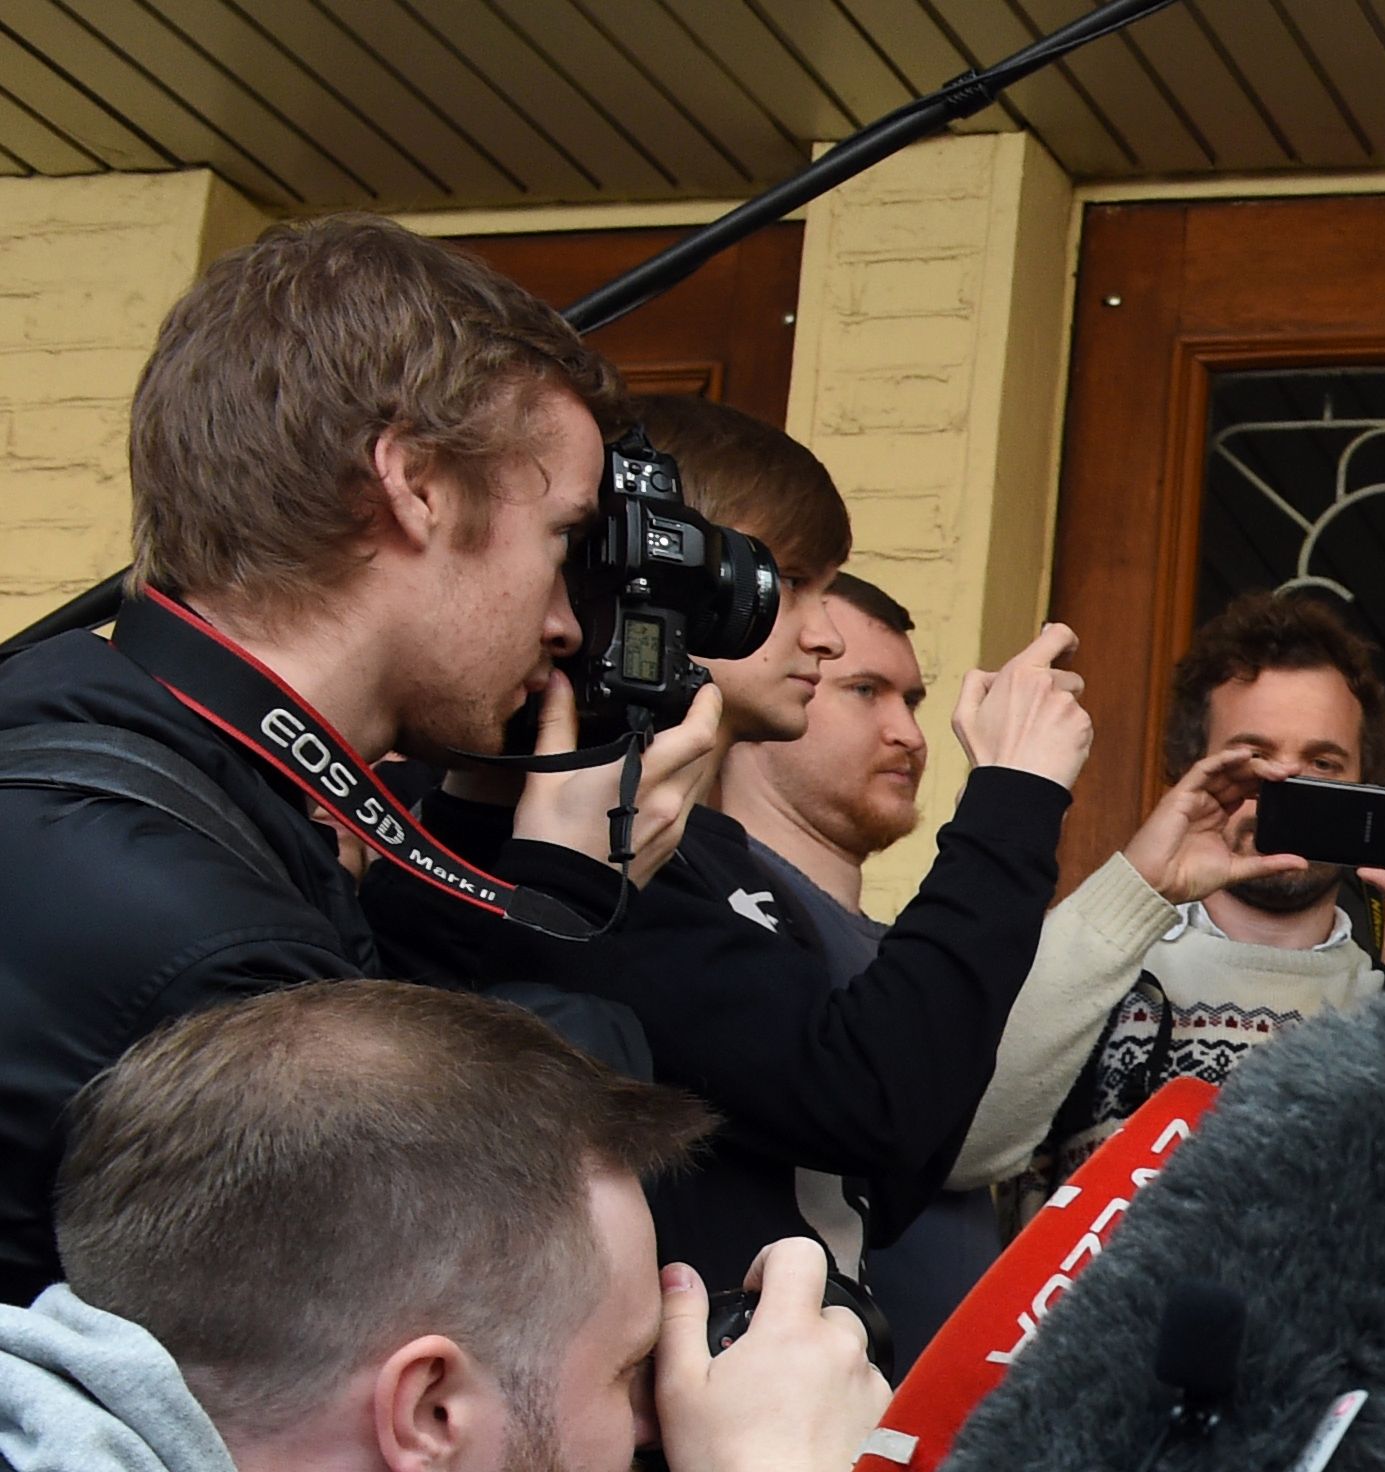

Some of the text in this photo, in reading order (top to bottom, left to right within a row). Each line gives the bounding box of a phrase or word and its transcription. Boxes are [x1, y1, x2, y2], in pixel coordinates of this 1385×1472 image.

[260, 707, 359, 798] EOS
[355, 797, 406, 845] 5D
[409, 848, 477, 893] Mark
